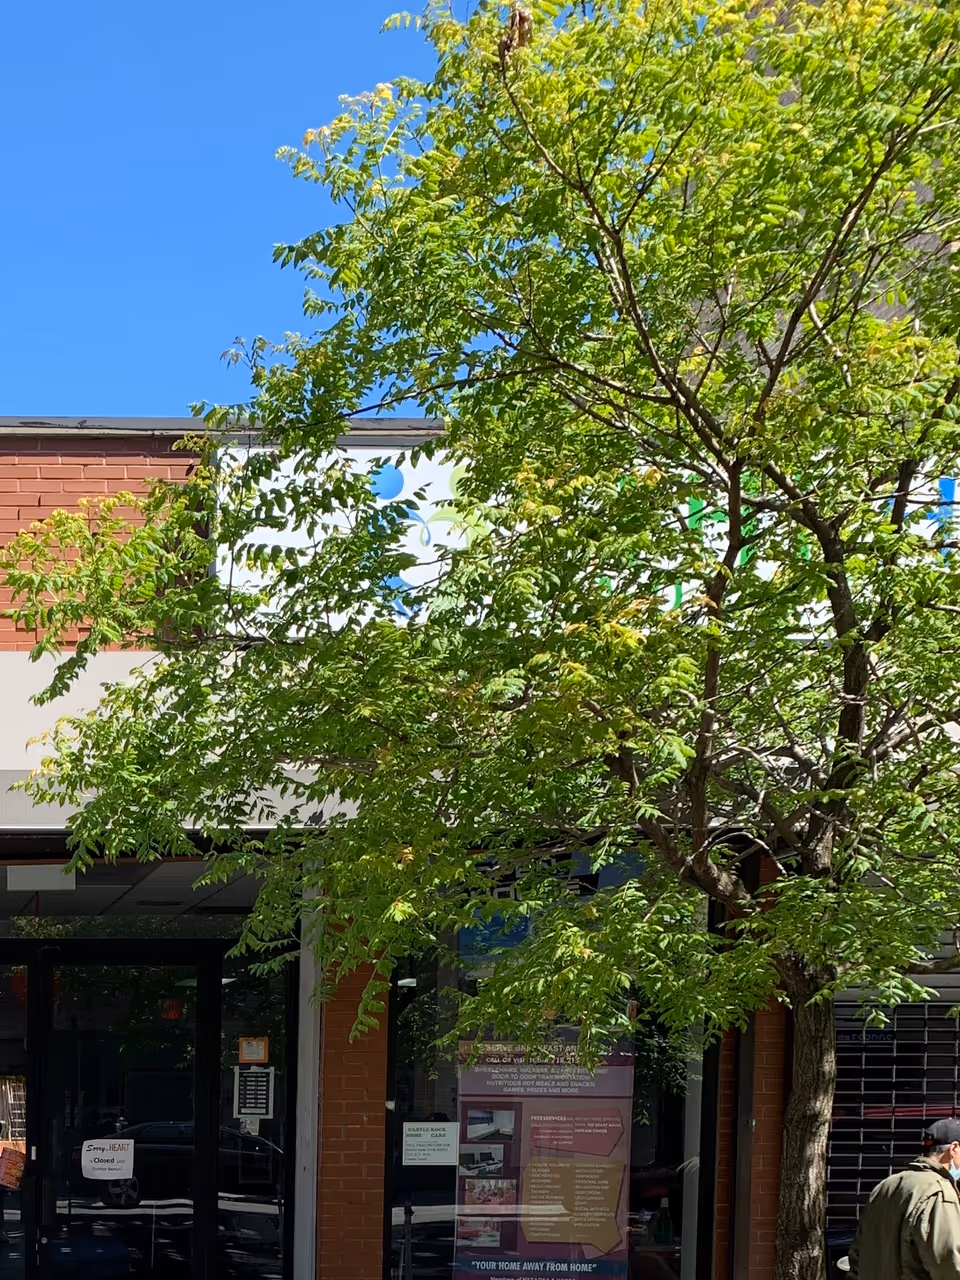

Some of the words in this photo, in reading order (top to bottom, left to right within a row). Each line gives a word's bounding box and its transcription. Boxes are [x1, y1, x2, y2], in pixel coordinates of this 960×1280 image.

[109, 1143, 130, 1152] HEART
[498, 1261, 521, 1271] HOME
[522, 1261, 545, 1271] AWAY
[546, 1262, 569, 1272] FROM
